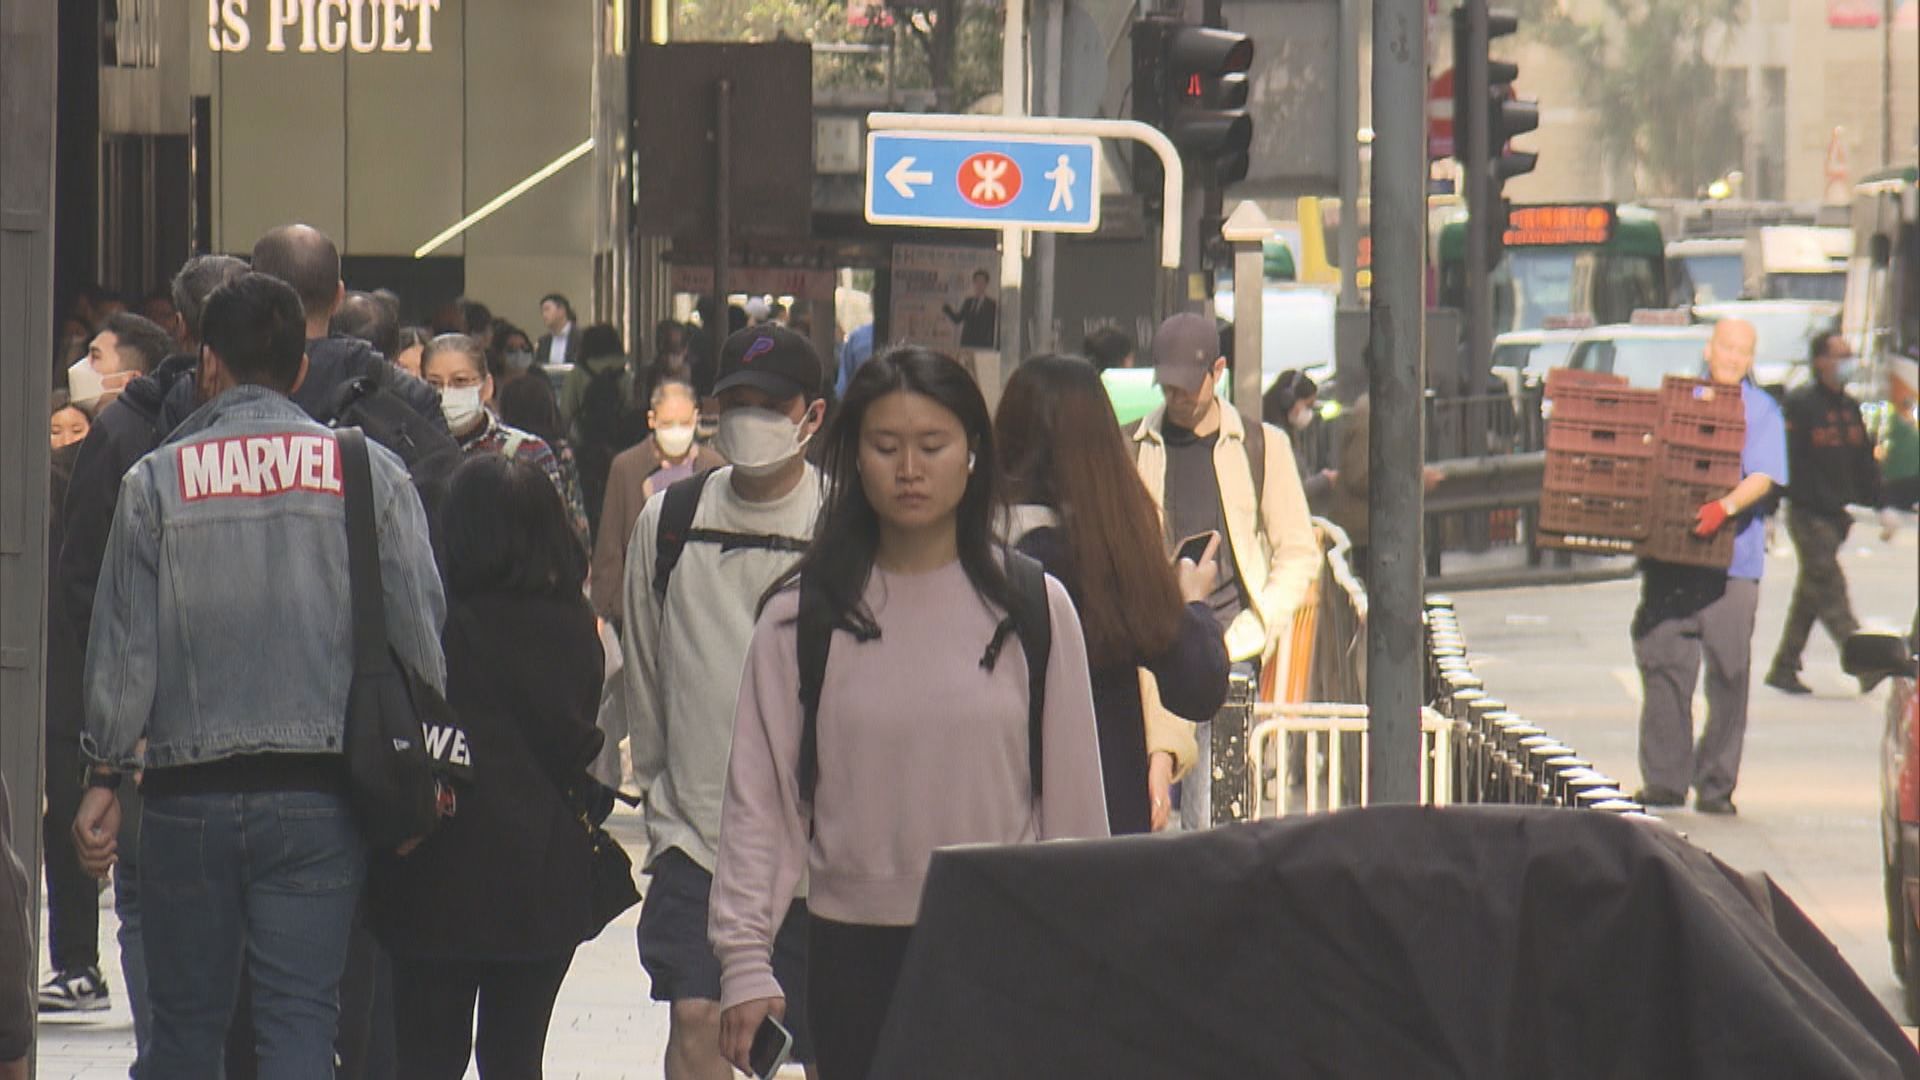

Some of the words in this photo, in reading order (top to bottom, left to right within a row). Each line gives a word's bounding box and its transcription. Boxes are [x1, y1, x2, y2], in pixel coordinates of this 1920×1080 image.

[208, 0, 250, 52] S
[266, 0, 441, 53] PIGUET
[181, 435, 341, 499] MARVEL
